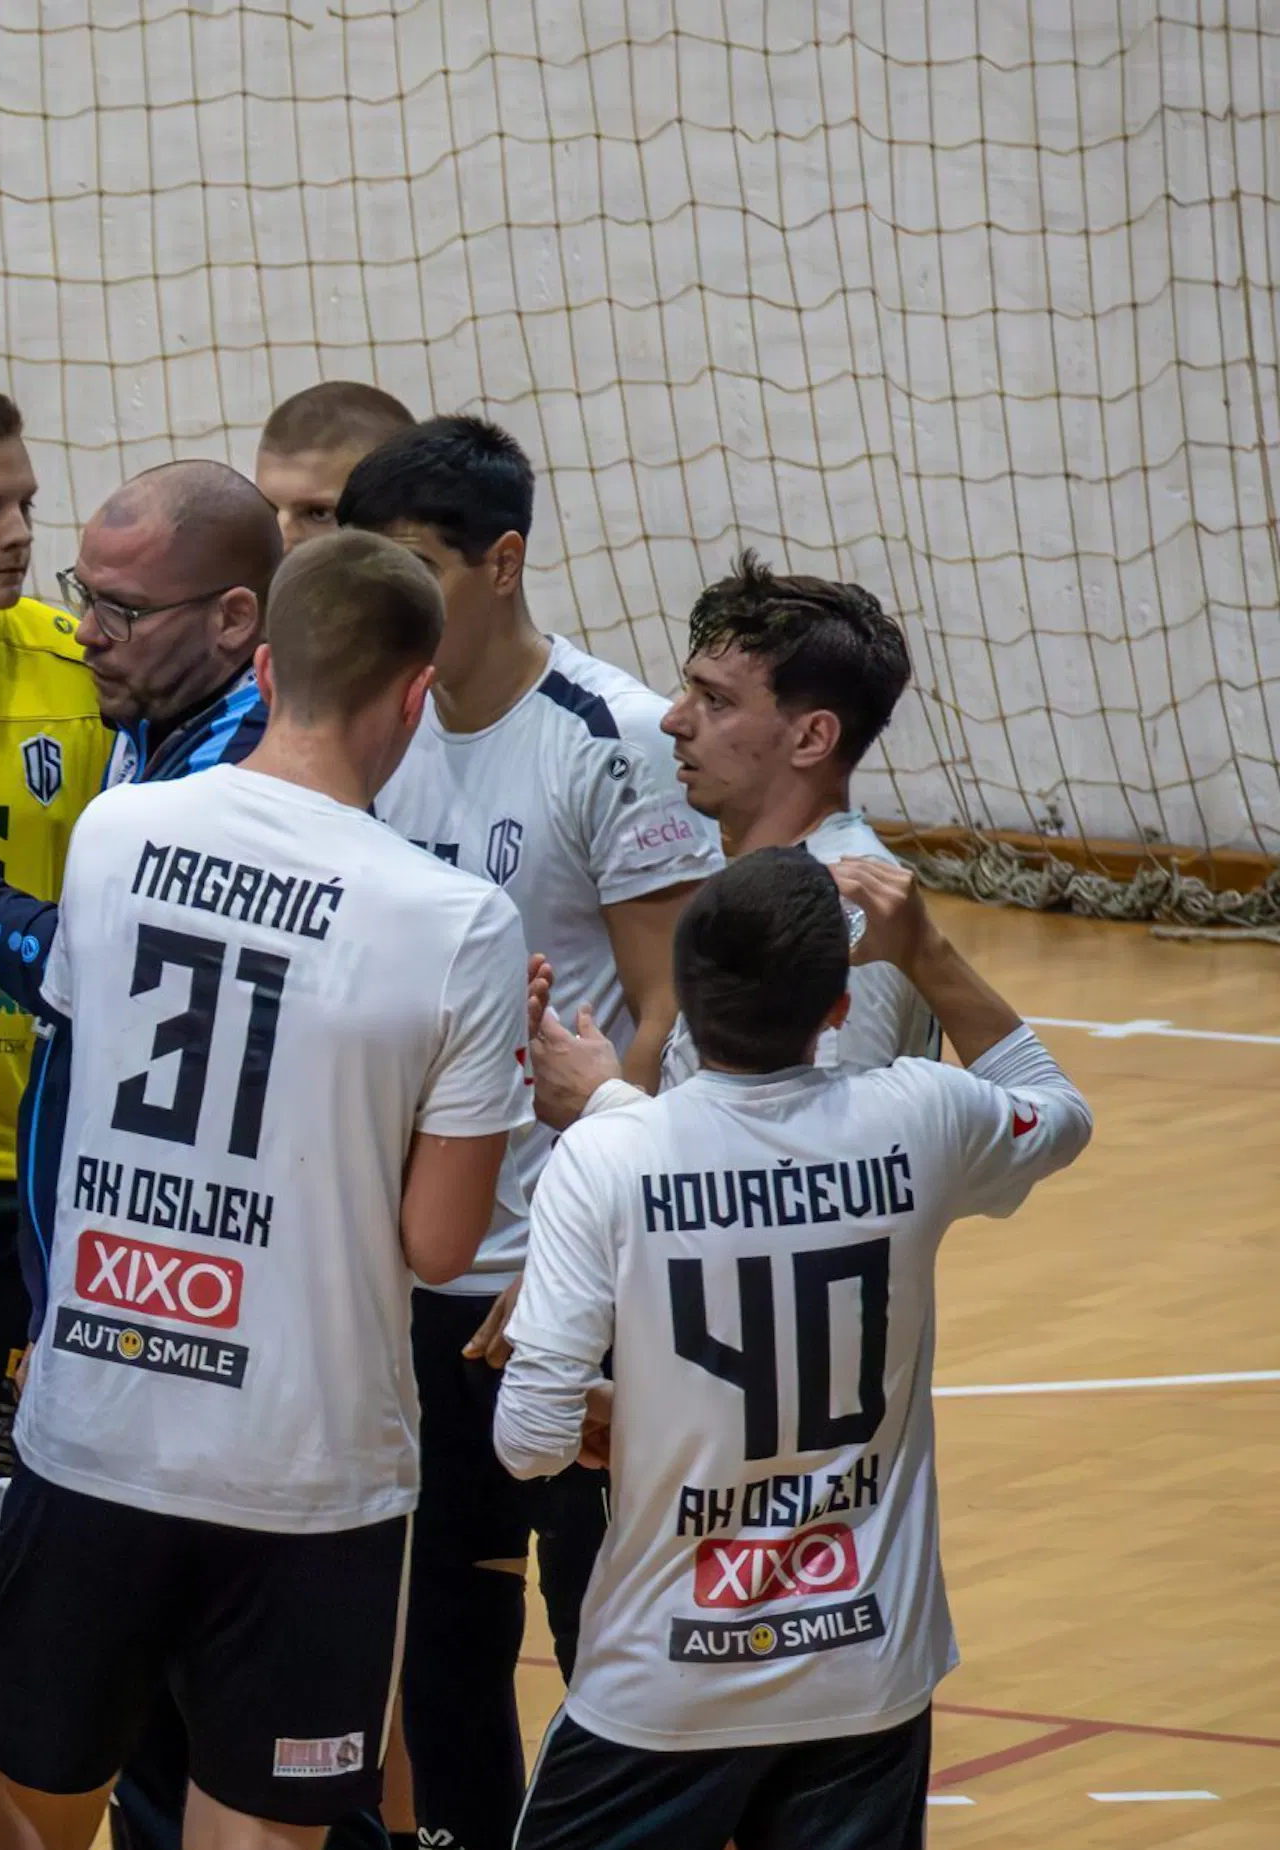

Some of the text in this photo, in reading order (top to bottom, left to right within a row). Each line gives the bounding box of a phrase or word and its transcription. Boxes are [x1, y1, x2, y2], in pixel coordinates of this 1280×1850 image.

[130, 839, 345, 941] MAGANIĆ
[110, 921, 291, 1161] 31
[73, 1154, 275, 1249] RK OSIJEK
[641, 1144, 915, 1233] KOVAČEVIĆ
[87, 1240, 234, 1319] XIXO
[146, 1335, 236, 1376] SMILE
[667, 1236, 891, 1462] 40
[676, 1484, 736, 1537] RK
[707, 1533, 846, 1601] XIXO
[782, 1604, 873, 1648] SMILE
